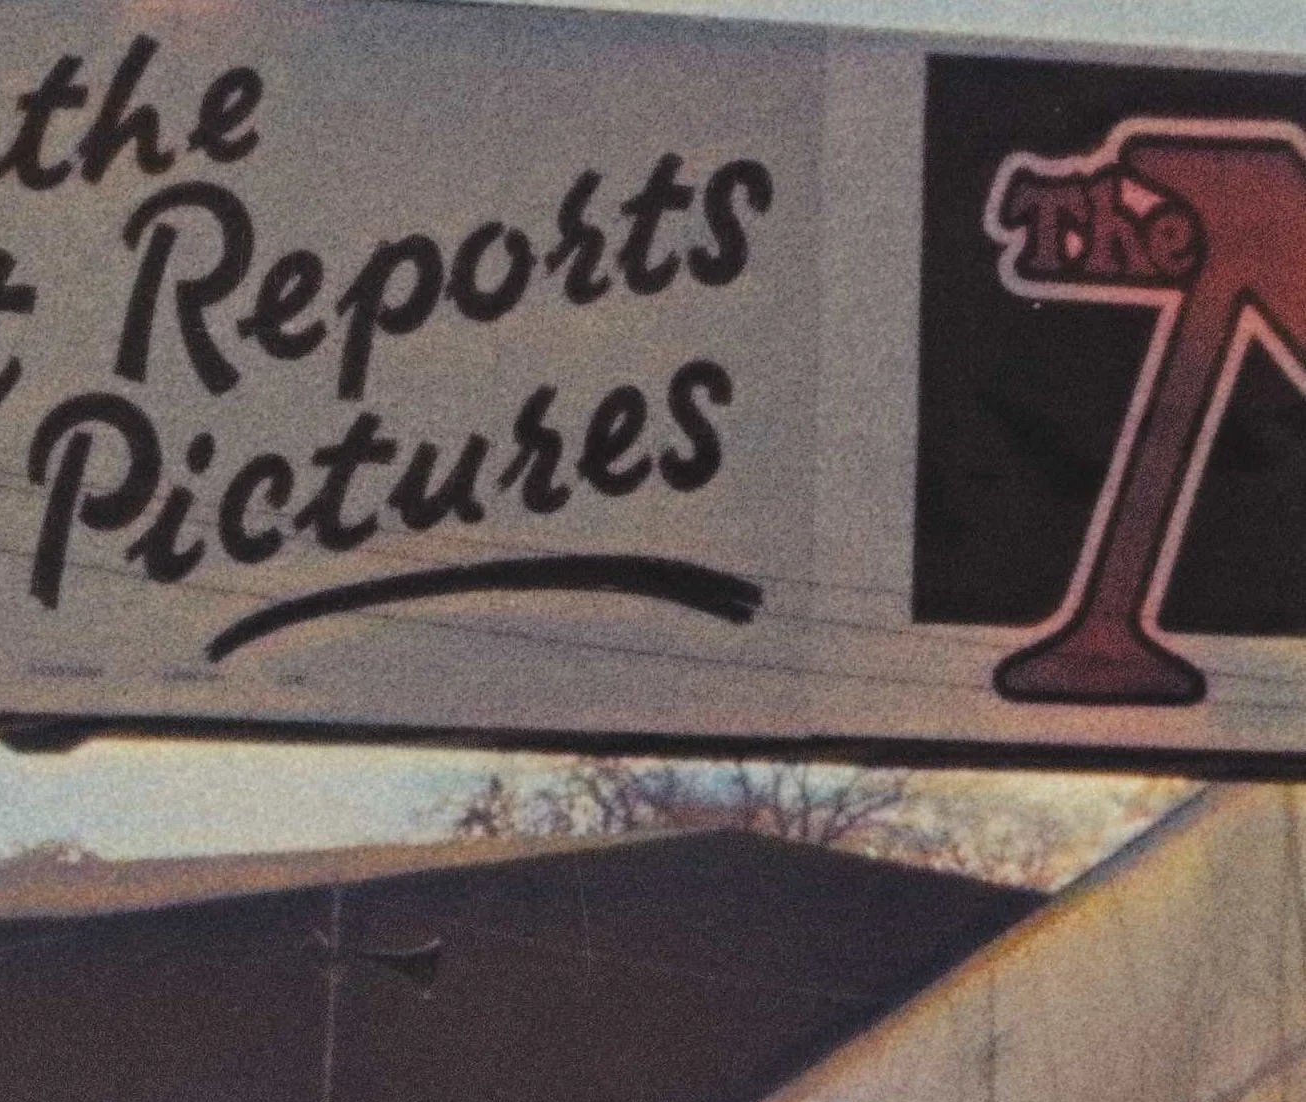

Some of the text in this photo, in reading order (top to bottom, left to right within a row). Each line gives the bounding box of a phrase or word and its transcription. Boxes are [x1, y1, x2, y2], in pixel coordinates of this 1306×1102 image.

[114, 154, 774, 400] Reports
[999, 166, 1199, 278] The
[27, 359, 734, 608] Pictures
